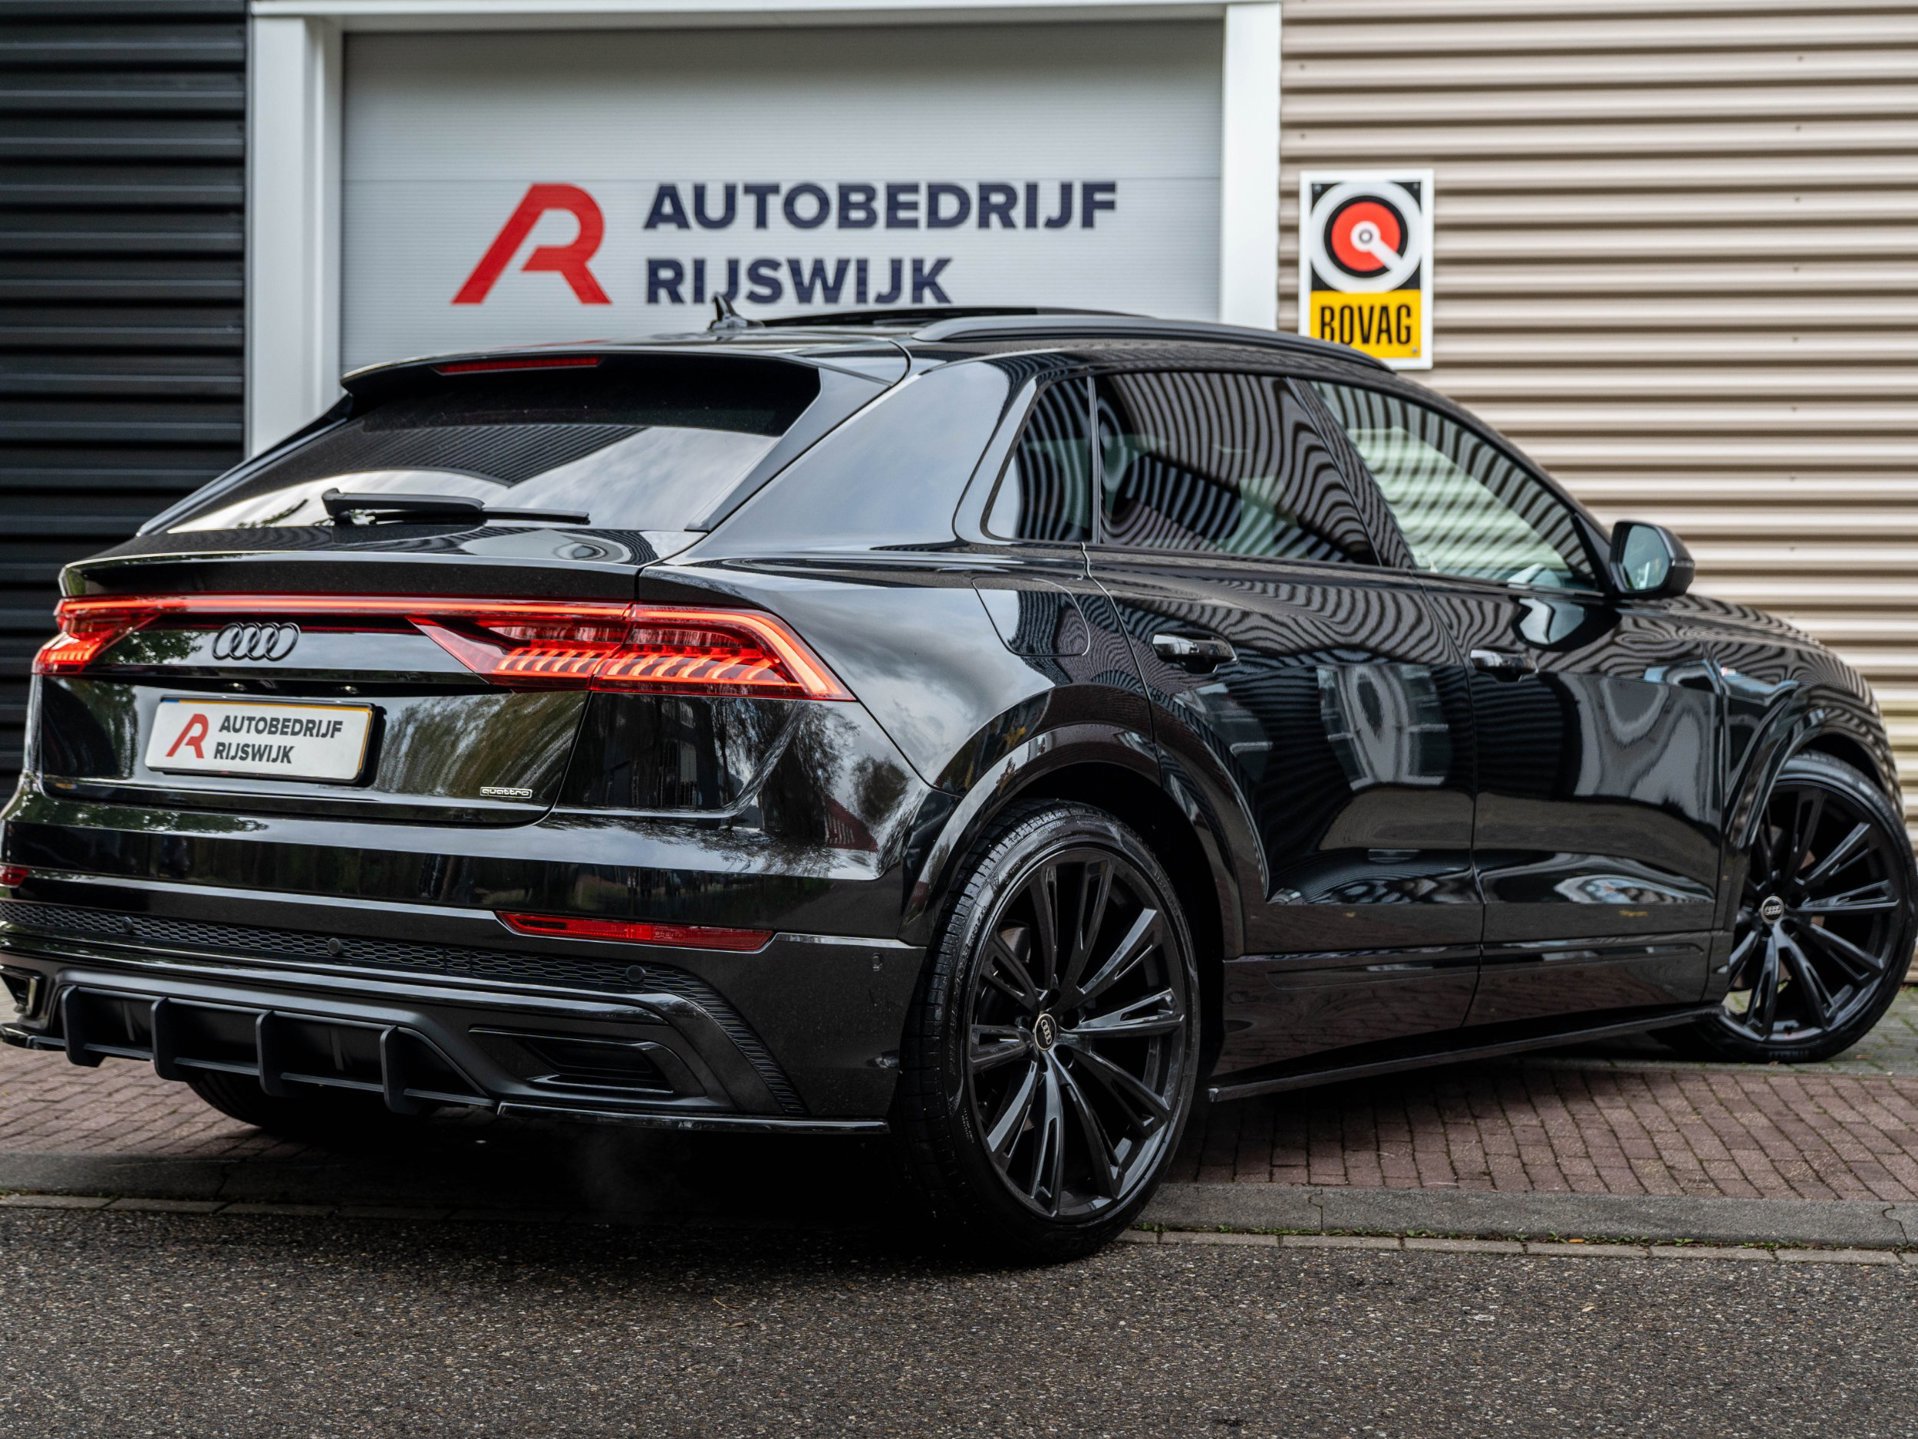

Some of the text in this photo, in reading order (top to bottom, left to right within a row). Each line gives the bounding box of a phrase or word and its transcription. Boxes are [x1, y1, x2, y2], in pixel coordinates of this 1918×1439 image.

[643, 182, 1118, 230] AUTOBEDRIJF
[646, 258, 954, 304] RIJSWIJK
[218, 715, 343, 738] AUTOBEDRIJF
[213, 742, 295, 764] RIJSWIJK
[481, 787, 531, 797] quattro
